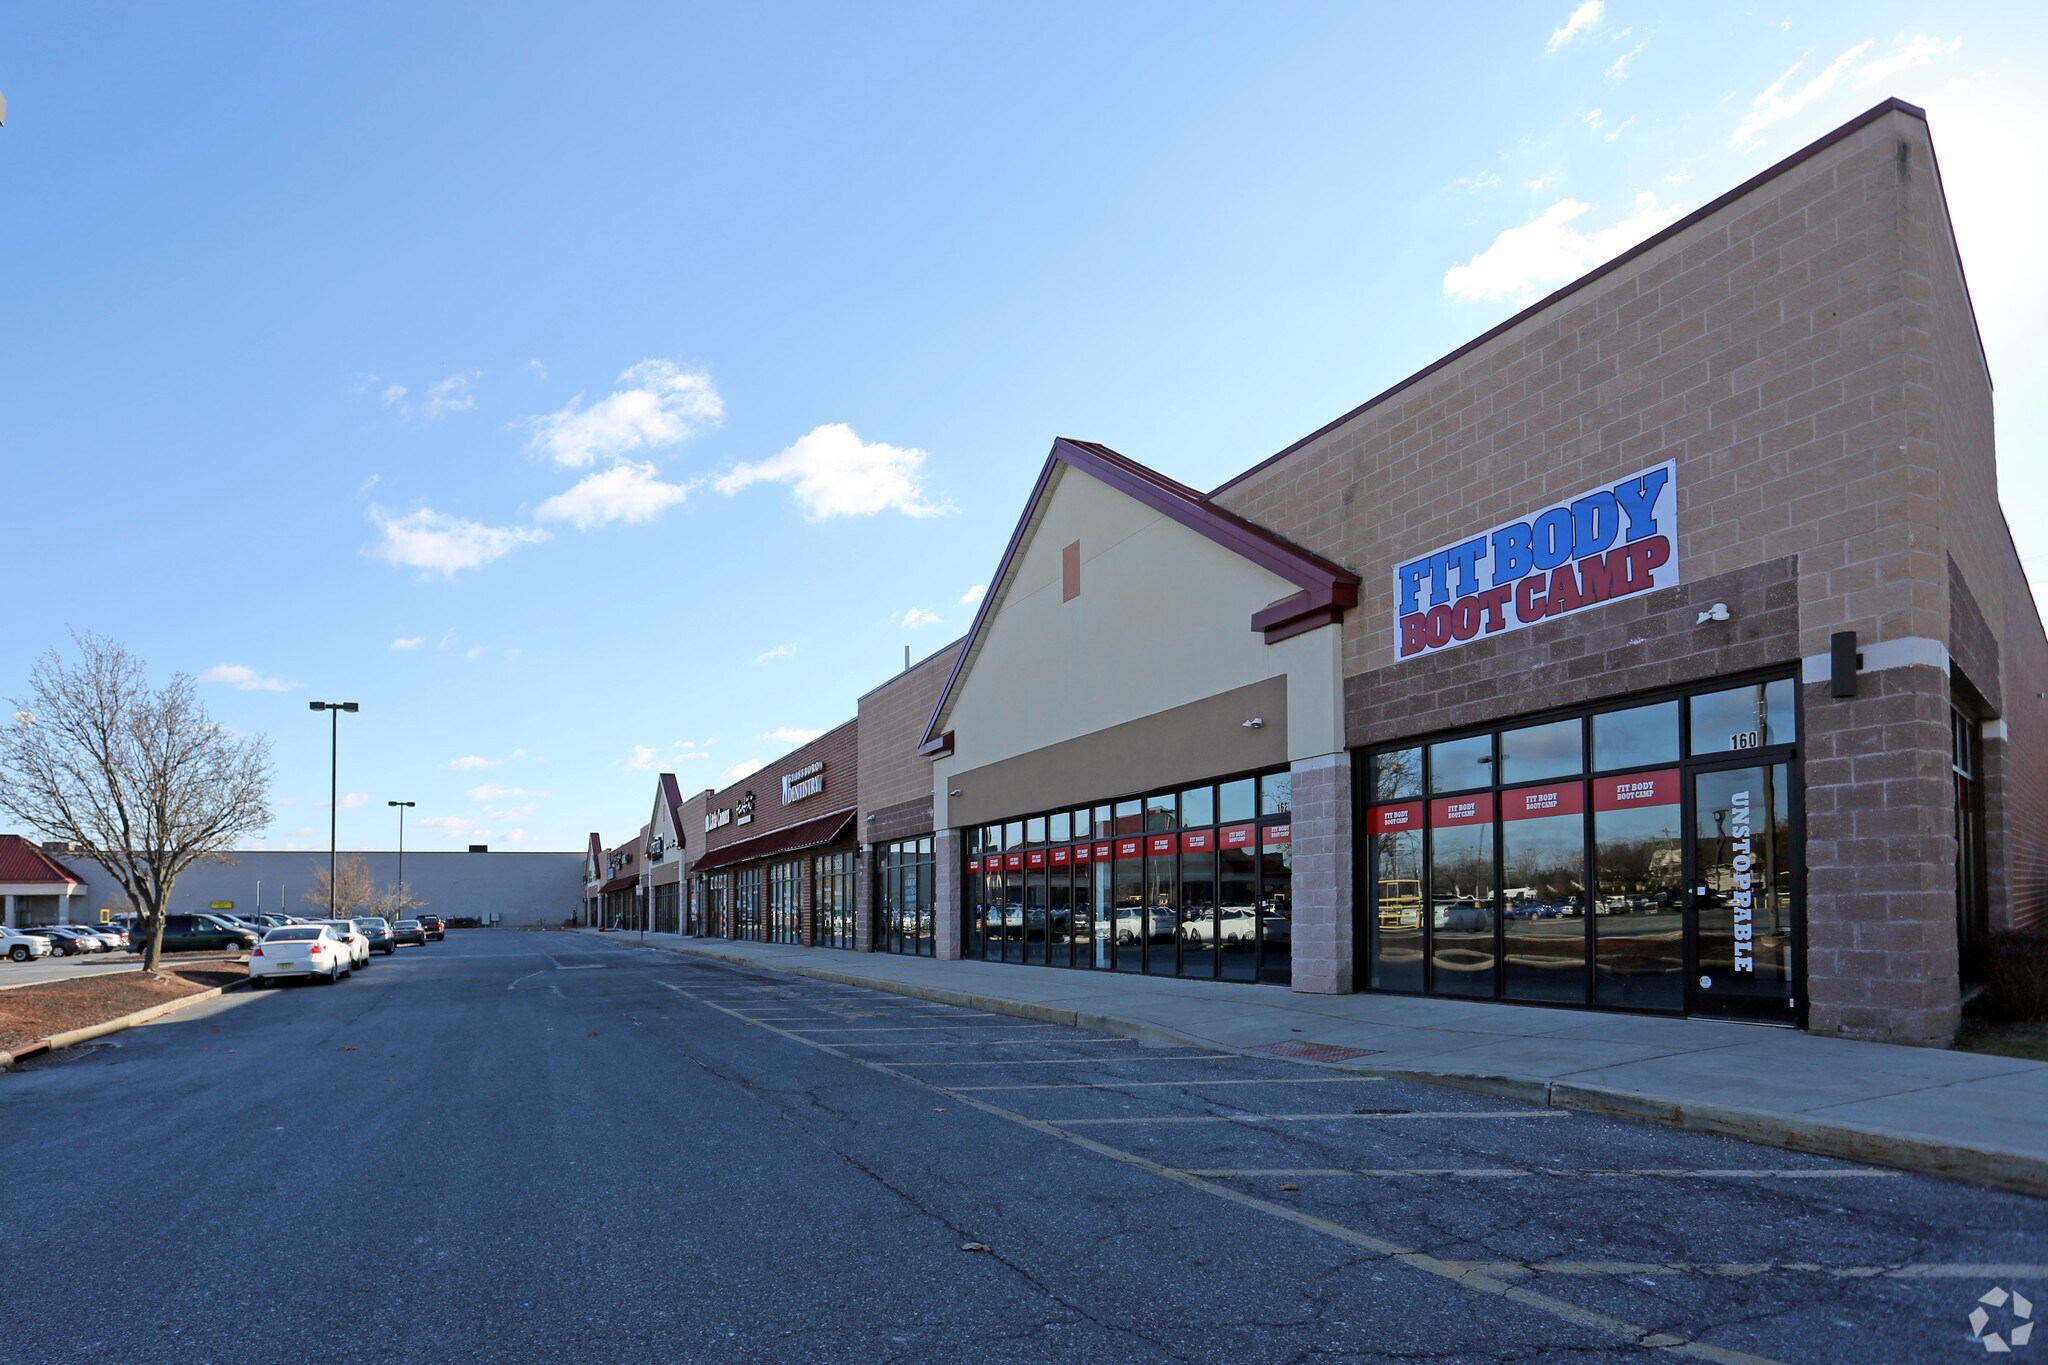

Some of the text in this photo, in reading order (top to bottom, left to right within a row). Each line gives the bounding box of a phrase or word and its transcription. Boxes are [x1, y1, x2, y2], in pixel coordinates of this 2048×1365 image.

[1399, 467, 1668, 616] FIT BODY
[1400, 535, 1670, 657] BOOT CAMP
[1731, 732, 1757, 750] 160
[1616, 781, 1654, 793] FIT BODY
[1526, 792, 1558, 803] FIT BODY
[1617, 789, 1654, 801] BOOT CAMP
[1459, 802, 1475, 811] BODY
[1541, 800, 1558, 808] CAMP
[1448, 809, 1475, 819] BOOT CAMP
[1731, 790, 1753, 972] UNSTOPPABLE
